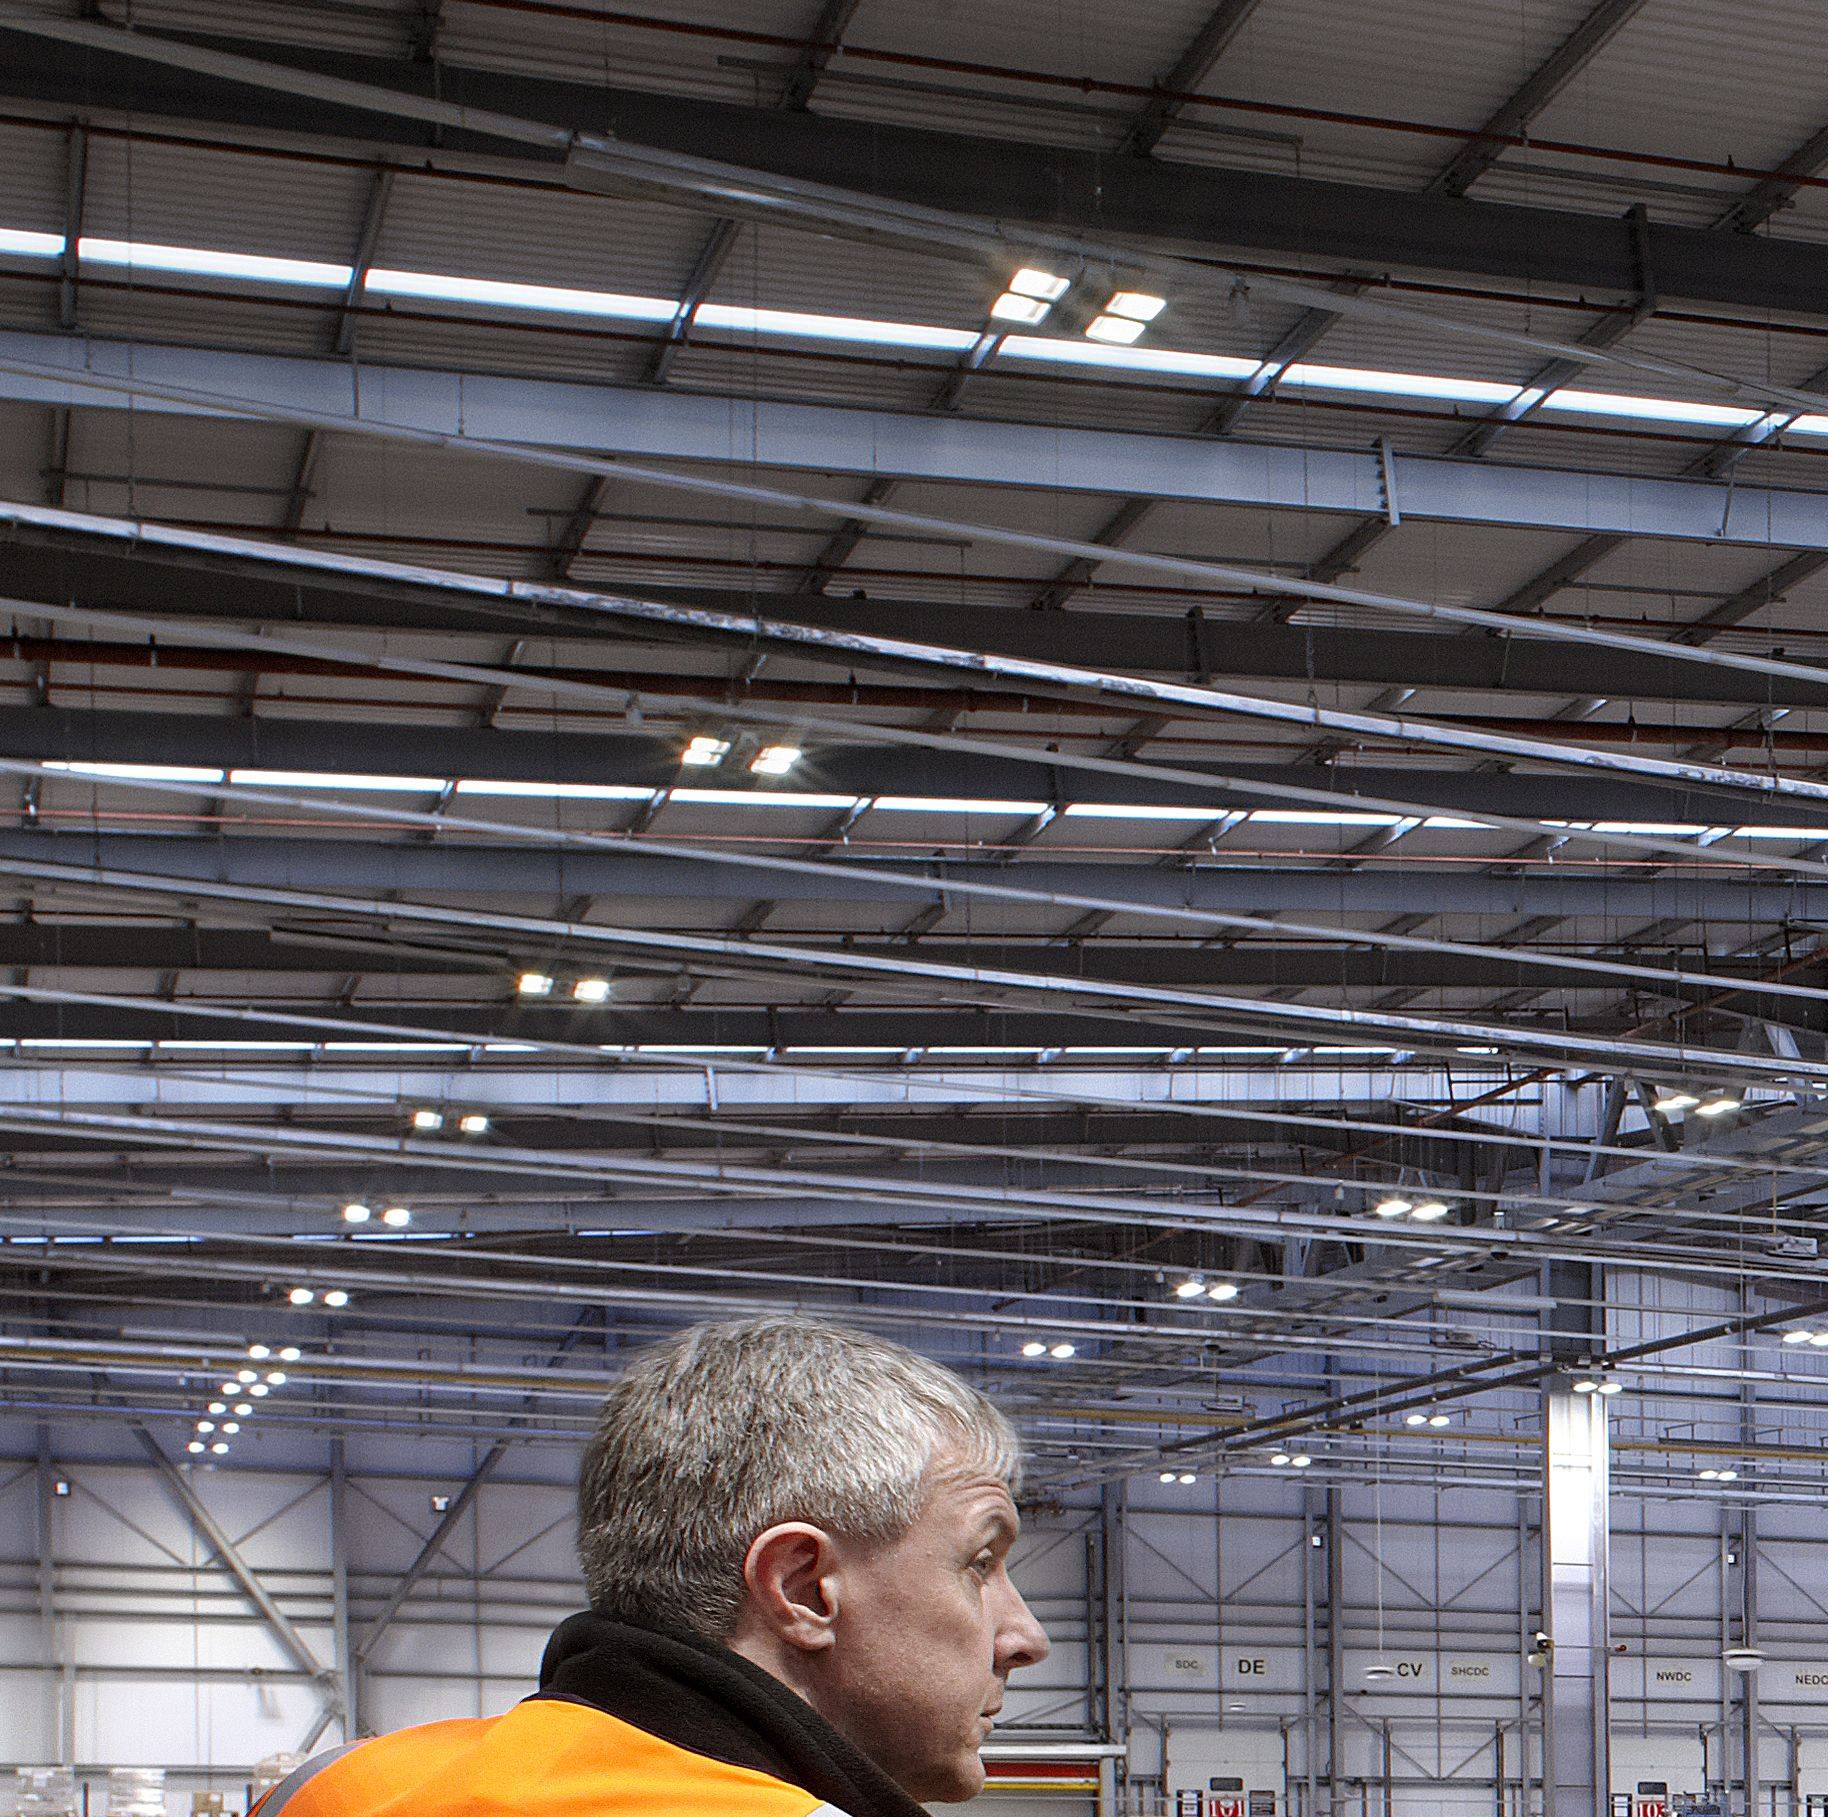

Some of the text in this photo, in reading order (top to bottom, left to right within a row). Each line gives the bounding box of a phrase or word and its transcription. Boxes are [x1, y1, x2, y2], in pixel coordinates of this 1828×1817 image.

[1175, 1659, 1198, 1669] SDC
[1238, 1659, 1265, 1675] DE
[1397, 1663, 1422, 1677] CV
[1656, 1671, 1692, 1682] NWDC
[1795, 1675, 1828, 1685] NEDC
